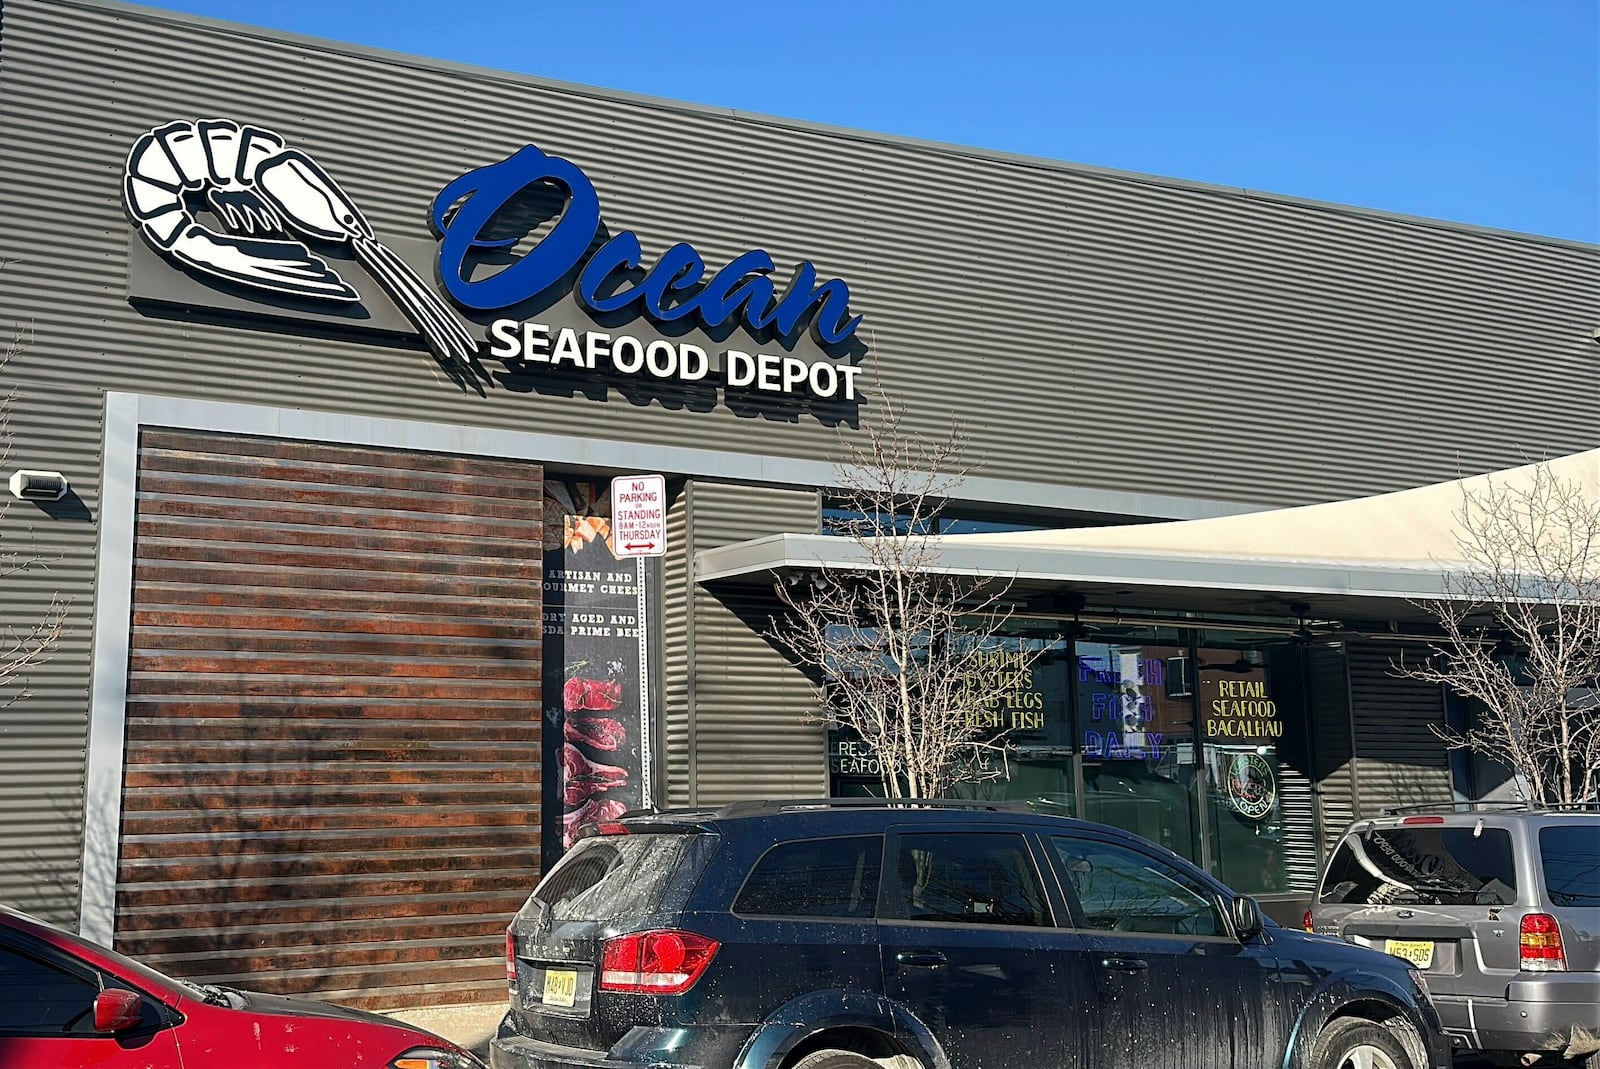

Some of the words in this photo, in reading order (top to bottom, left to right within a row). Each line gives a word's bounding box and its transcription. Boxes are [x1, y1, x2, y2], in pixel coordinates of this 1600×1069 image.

[428, 143, 863, 345] Ocean
[490, 319, 709, 381] SEAFOOD
[727, 350, 862, 401] DEPOT
[631, 481, 645, 492] NO
[619, 492, 658, 503] PARKING
[618, 509, 661, 521] STANDING
[619, 529, 662, 541] THURSDAY
[548, 569, 601, 582] ARTISAN
[607, 572, 632, 583] AND
[543, 582, 595, 594] OURMET
[600, 584, 638, 596] CHEES
[572, 613, 604, 624] AGED
[610, 615, 636, 625] AND
[570, 626, 611, 637] PRIME
[616, 627, 639, 638] BEE
[1218, 679, 1269, 698] RETAIL
[1007, 691, 1043, 709] LEGS
[1212, 699, 1276, 718] SEAFOOD
[1011, 711, 1044, 729] FISH
[1207, 718, 1283, 738] BACALHAU
[1239, 799, 1269, 815] OPEN
